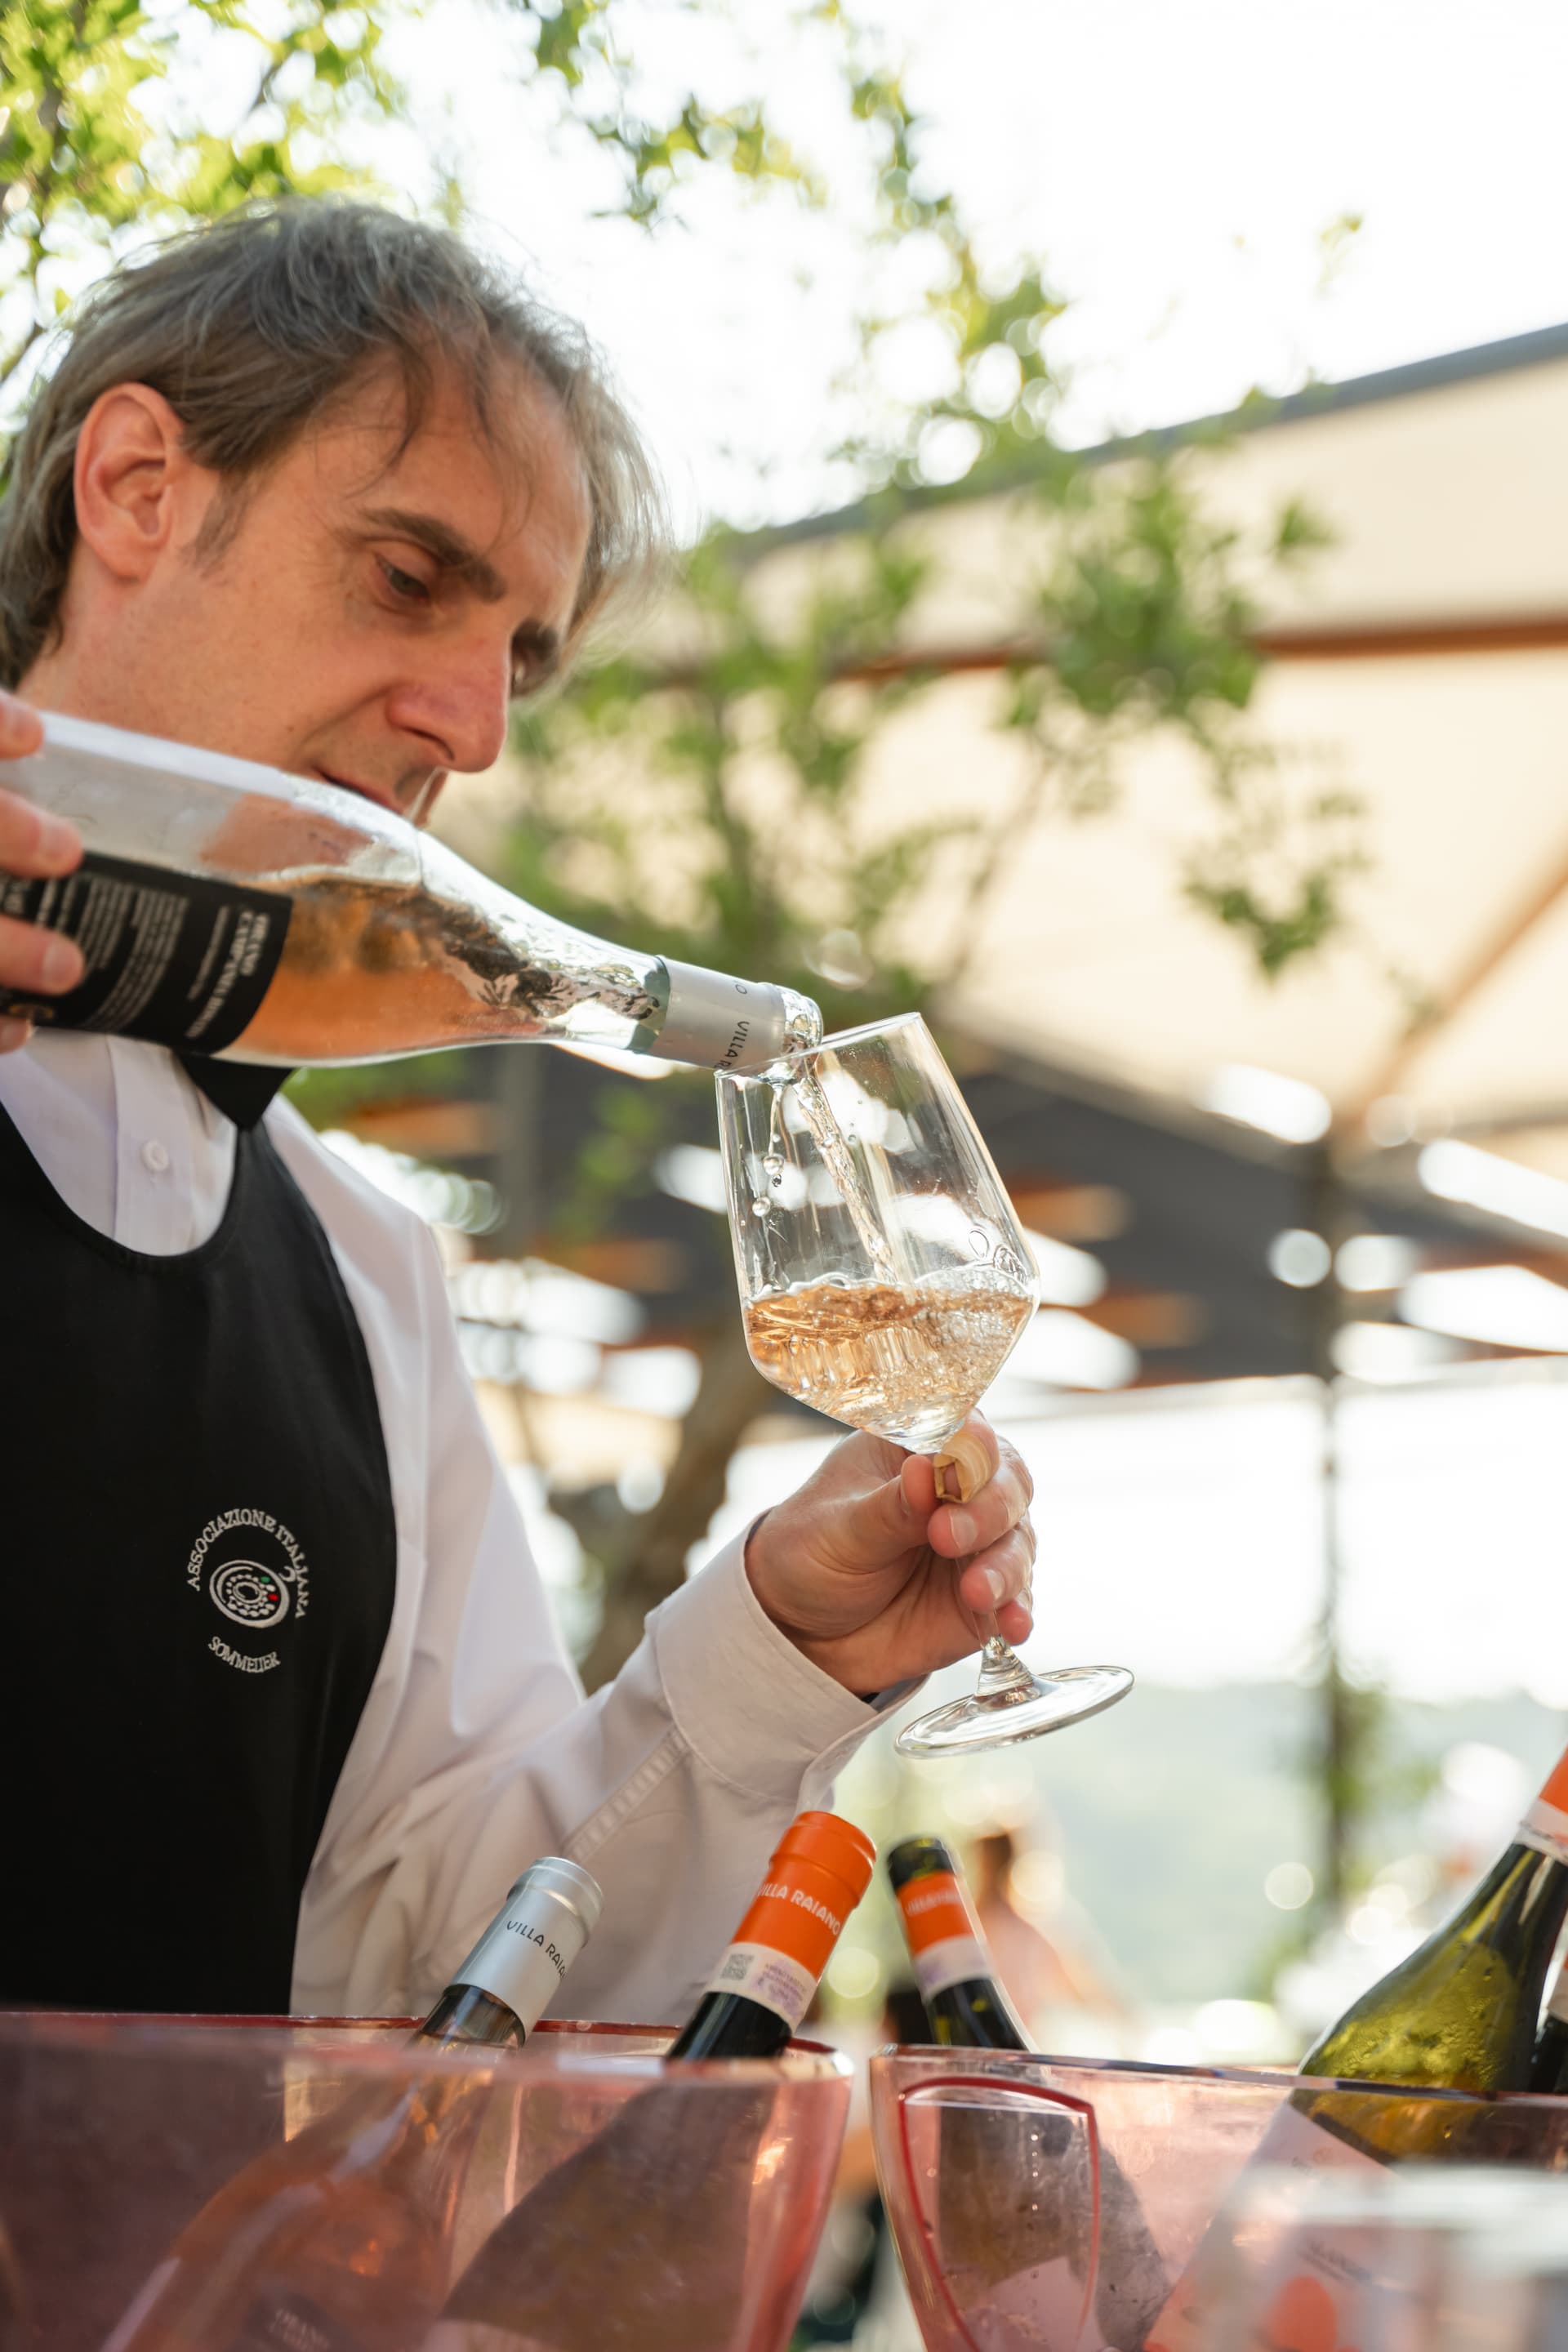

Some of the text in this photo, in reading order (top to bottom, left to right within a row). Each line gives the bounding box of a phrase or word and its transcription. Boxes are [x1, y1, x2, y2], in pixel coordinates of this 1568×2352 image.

[724, 1020, 750, 1058] VILLA
[187, 1508, 310, 1619] ASSOCIAZIONE ITALIANA
[208, 1636, 281, 1673] SOMMELIER
[756, 1883, 840, 1936] VILLA RAIANO
[506, 1920, 545, 1947] VILLA
